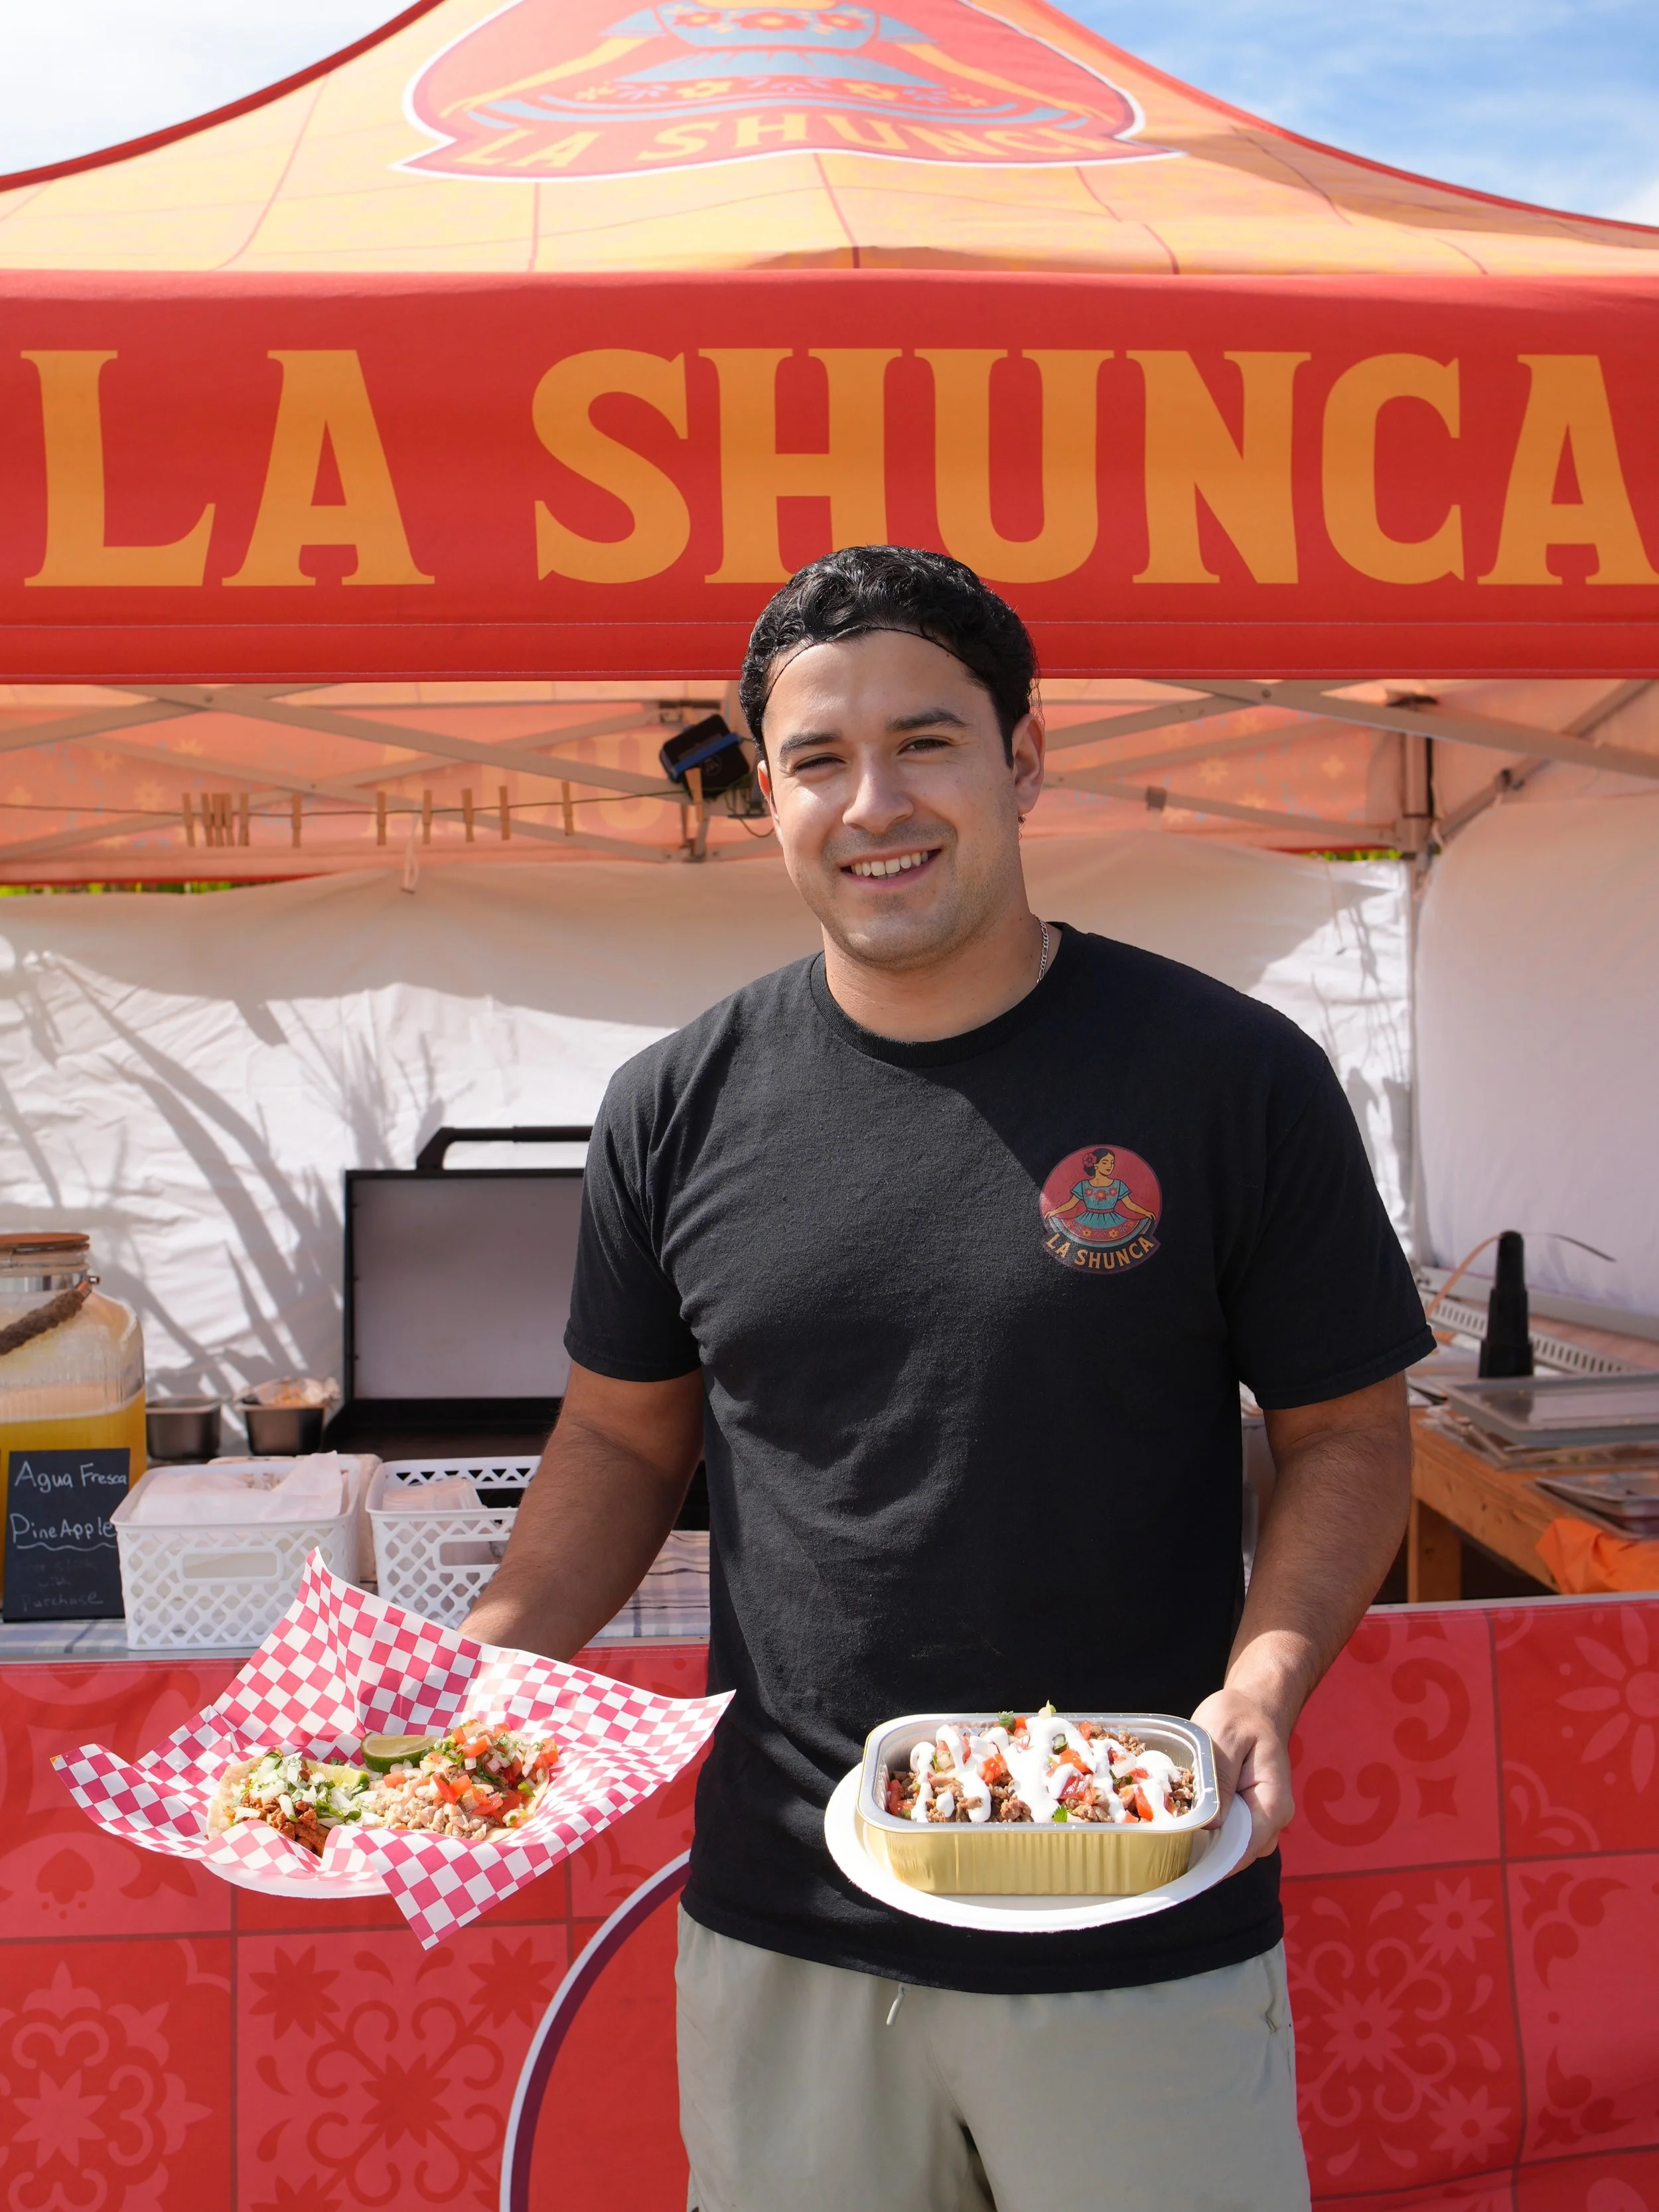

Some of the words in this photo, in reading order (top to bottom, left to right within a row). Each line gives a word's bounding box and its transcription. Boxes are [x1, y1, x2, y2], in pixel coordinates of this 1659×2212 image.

[453, 128, 605, 168] LA
[635, 113, 1128, 161] SHUNCA
[20, 349, 435, 587] LA
[532, 348, 1659, 585] SHUNCA
[1045, 1233, 1071, 1258] LA
[1074, 1236, 1155, 1269] SHUNCA
[14, 1460, 74, 1493] Agua
[80, 1462, 128, 1487] Fresca
